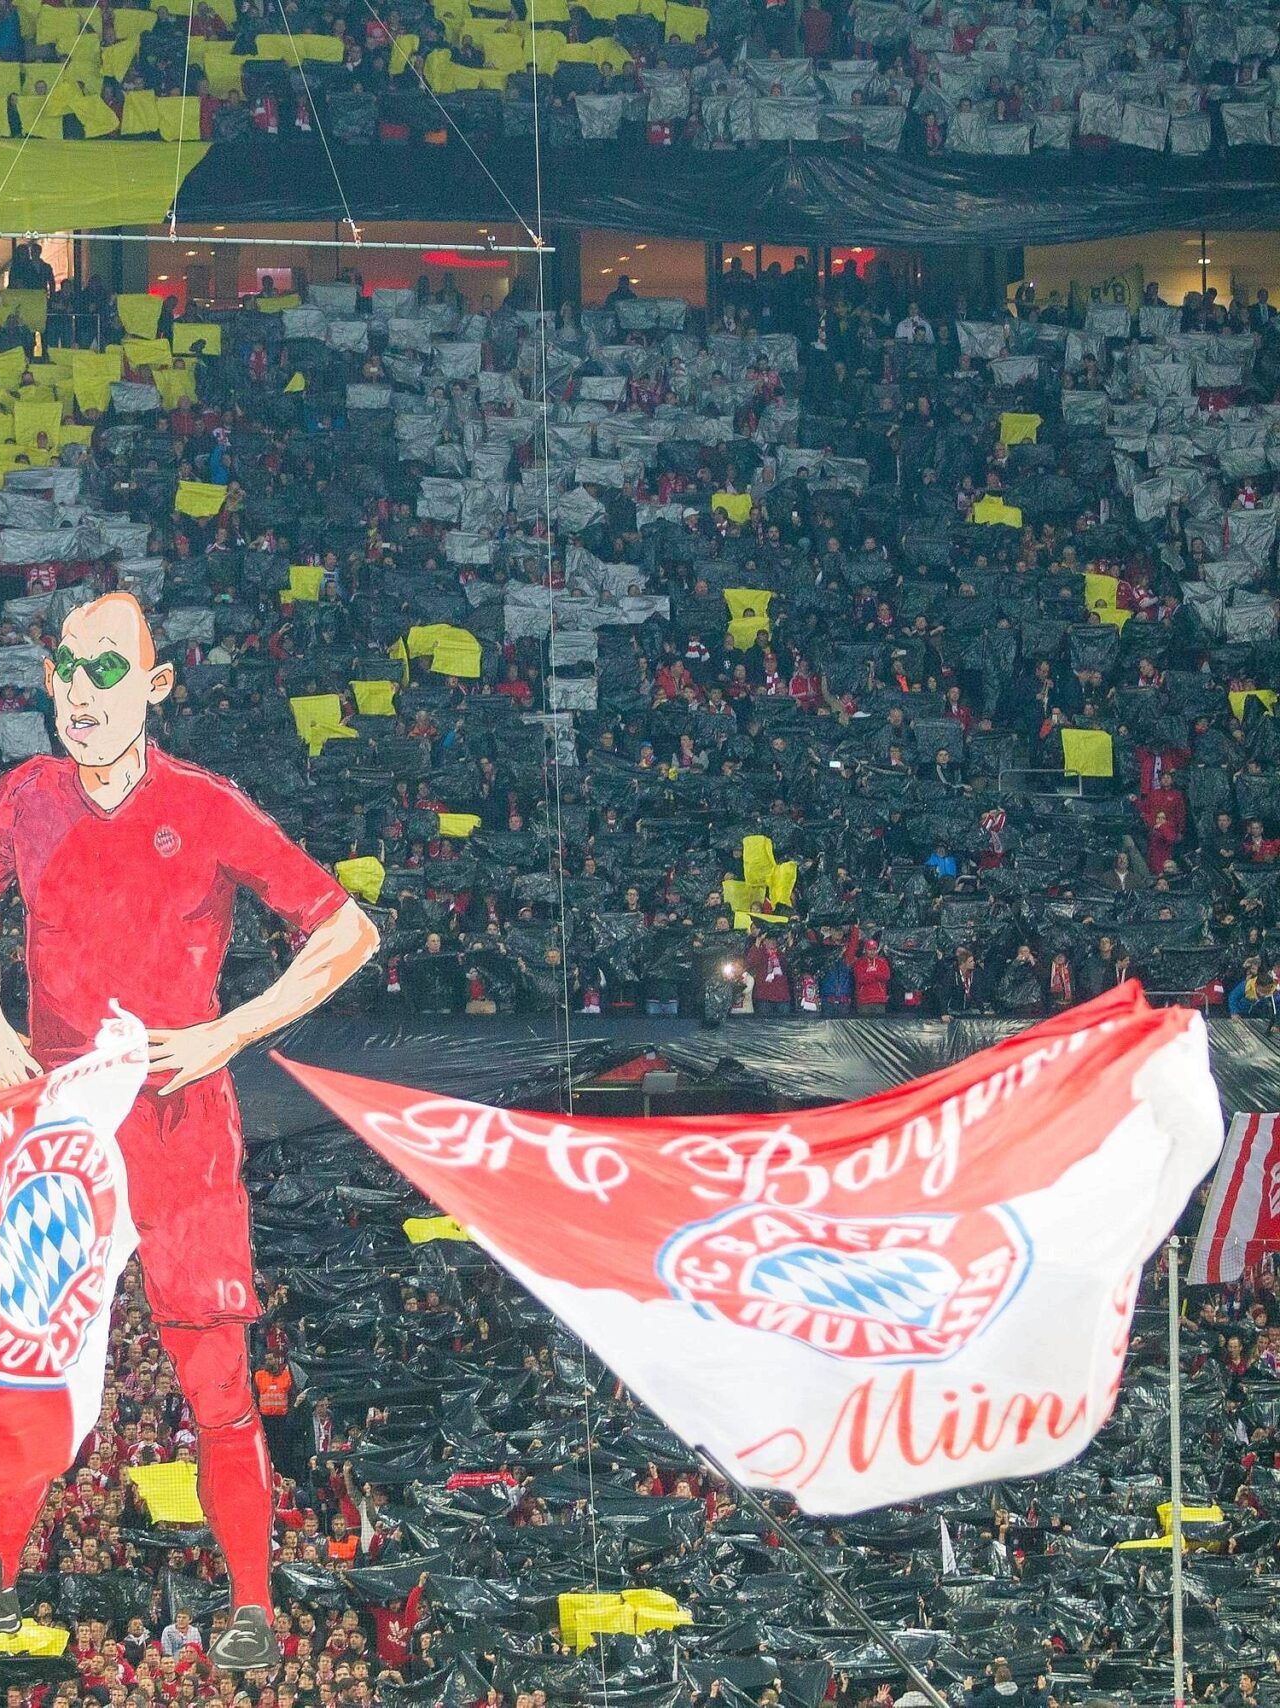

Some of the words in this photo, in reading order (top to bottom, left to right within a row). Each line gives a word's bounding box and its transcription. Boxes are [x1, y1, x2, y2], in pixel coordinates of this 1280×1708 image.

[4, 1133, 117, 1198] AYERN
[679, 1256, 732, 1291] FC
[217, 1279, 247, 1311] 10
